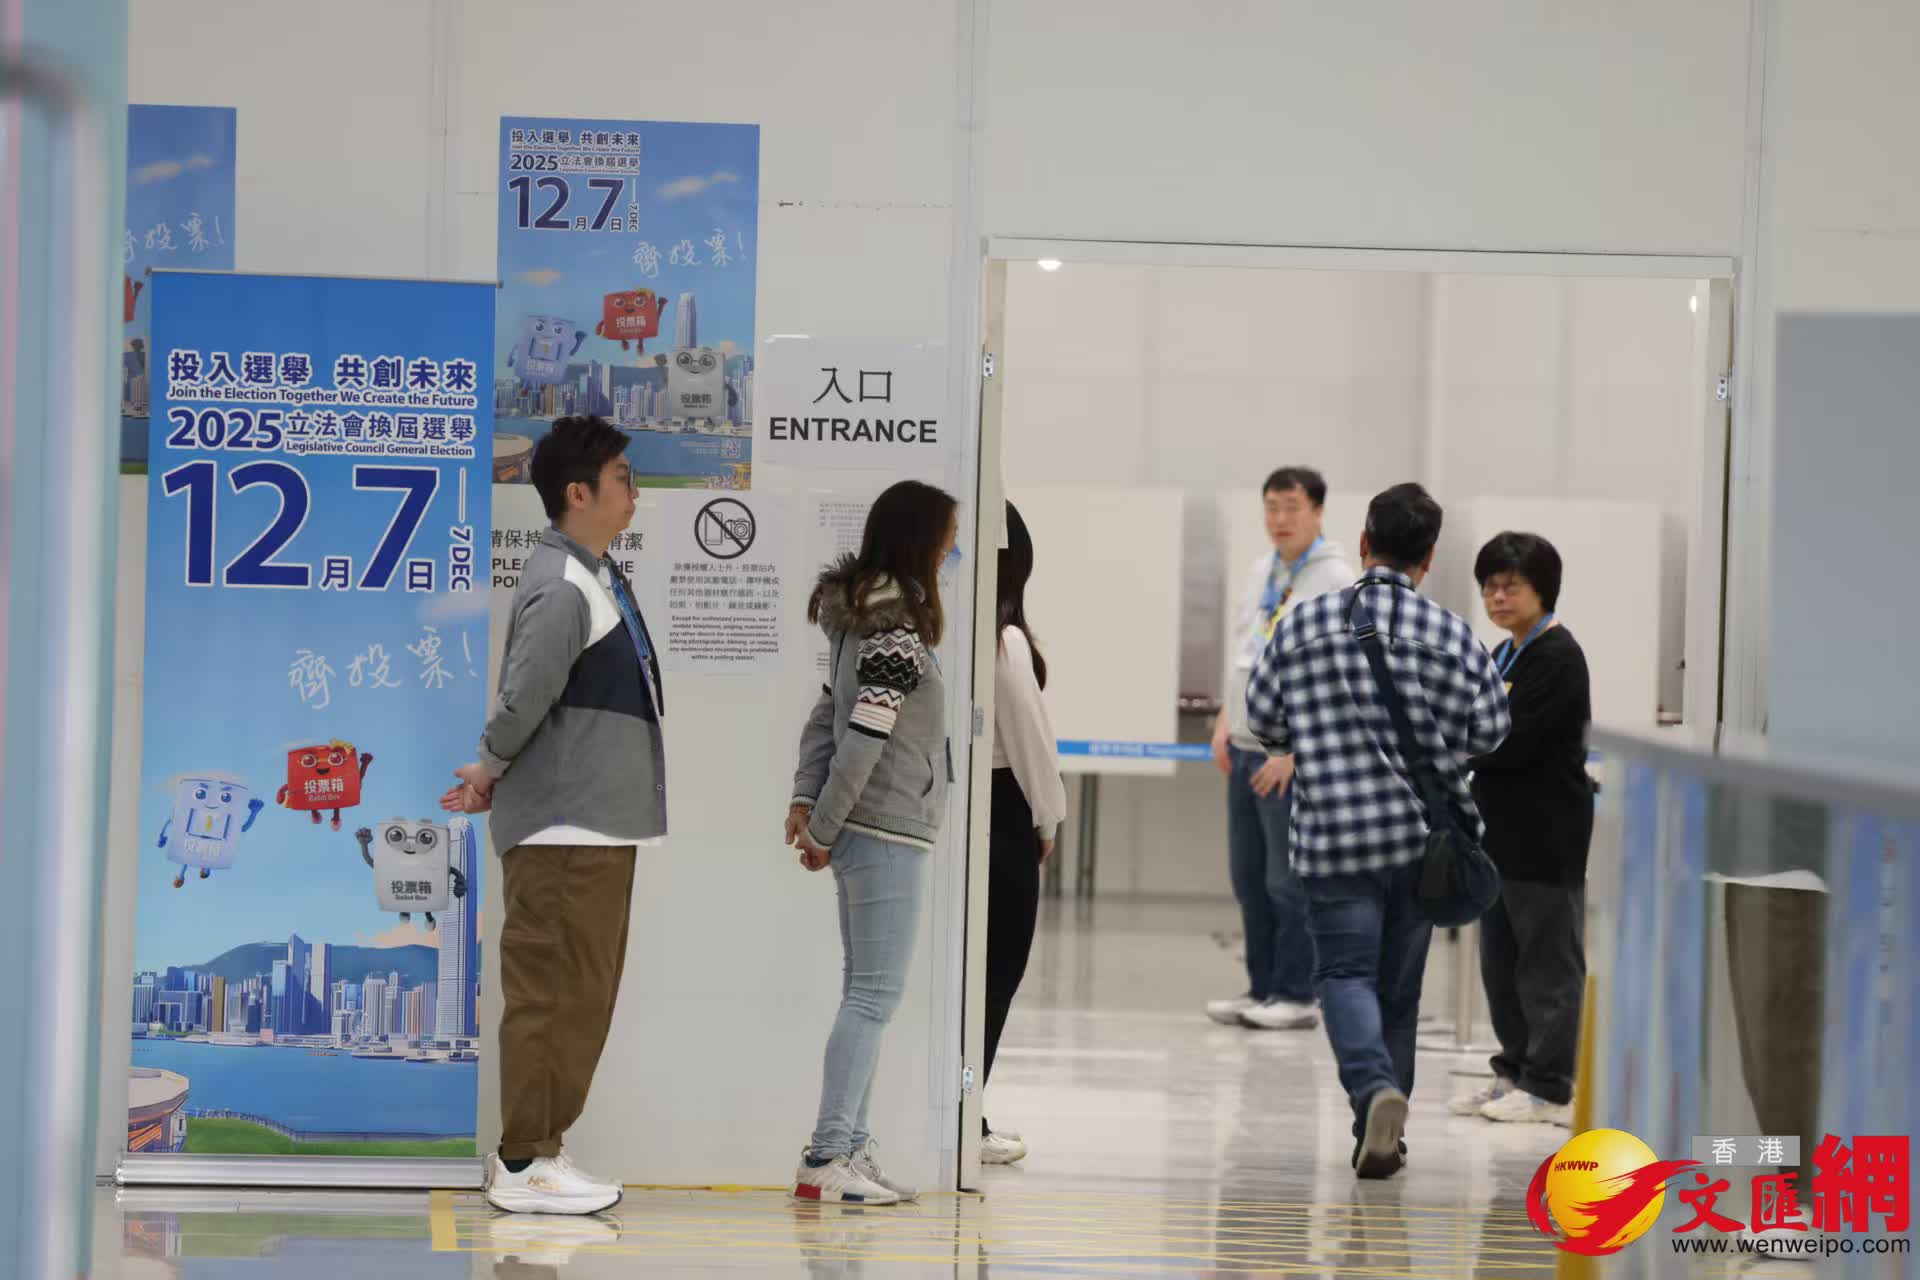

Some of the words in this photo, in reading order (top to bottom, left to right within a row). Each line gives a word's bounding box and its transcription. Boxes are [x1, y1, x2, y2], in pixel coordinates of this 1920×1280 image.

[511, 129, 570, 144] 投入選舉
[581, 132, 640, 146] 共創未來
[510, 154, 558, 171] 2025
[629, 203, 638, 211] 7
[629, 212, 638, 231] DEC
[170, 351, 310, 385] 投入選舉
[336, 357, 474, 391] 共創未來
[812, 366, 893, 404] 入口
[169, 385, 197, 398] Join
[200, 386, 222, 399] the
[224, 387, 277, 400] Election
[279, 388, 338, 404] Together
[340, 390, 361, 403] We
[363, 391, 406, 405] Create
[408, 393, 430, 405] the
[432, 394, 475, 407] Future
[168, 409, 282, 449] 2025
[286, 412, 474, 441] 立法會換屆選舉
[769, 416, 938, 444] ENTRANCE
[286, 440, 344, 454] Legislative
[345, 442, 385, 454] Council
[387, 444, 428, 455] General
[430, 445, 473, 456] Election
[452, 526, 472, 543] 7
[452, 545, 472, 591] DEC
[304, 777, 345, 795] 投票箱
[391, 880, 432, 895] 投票箱
